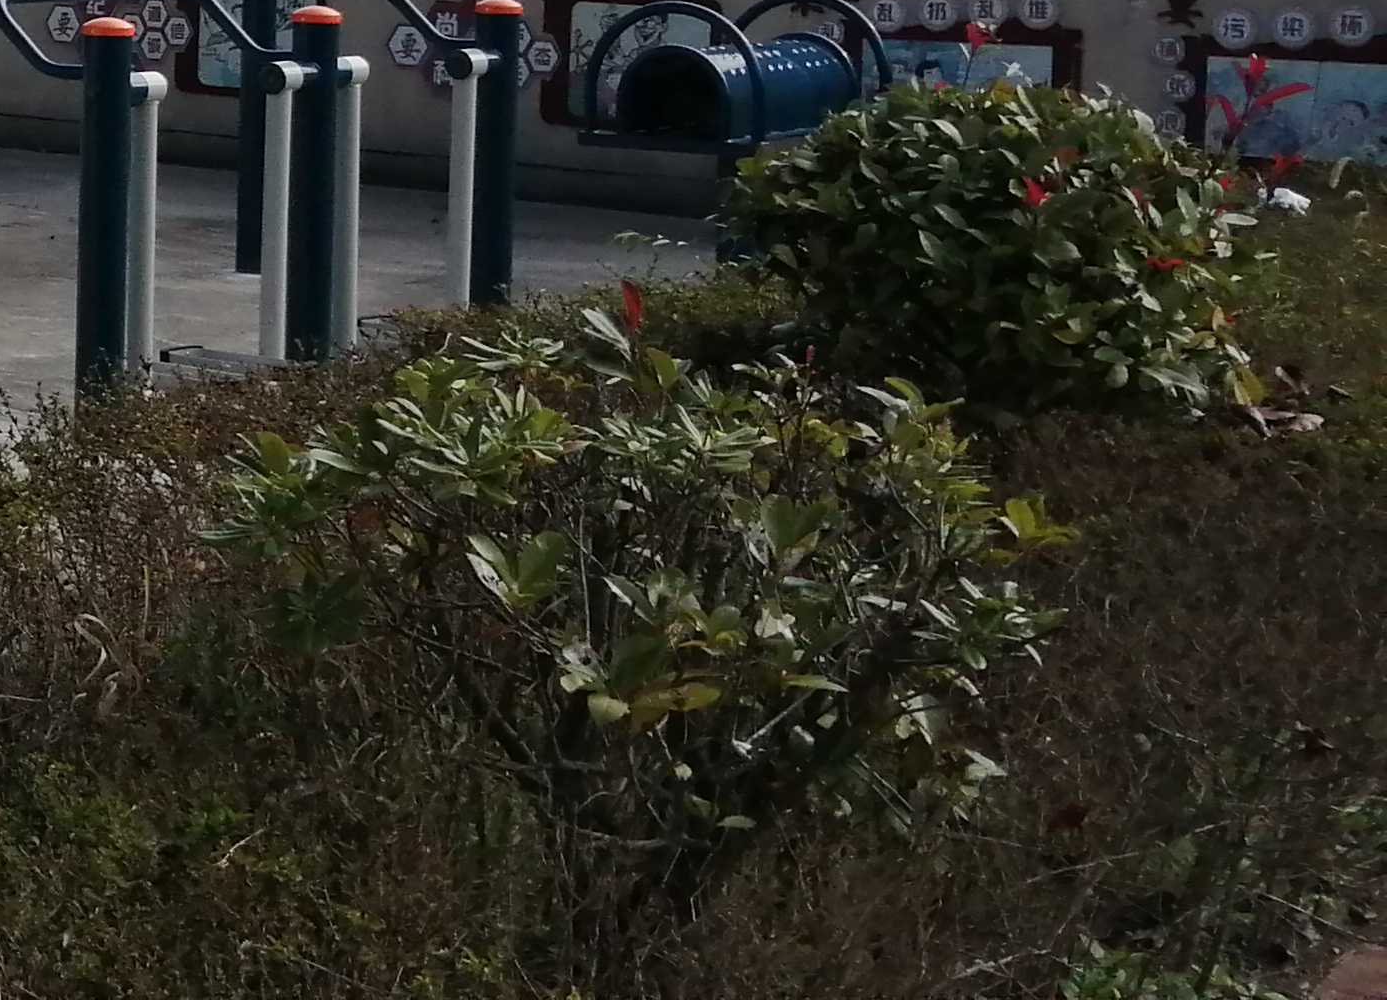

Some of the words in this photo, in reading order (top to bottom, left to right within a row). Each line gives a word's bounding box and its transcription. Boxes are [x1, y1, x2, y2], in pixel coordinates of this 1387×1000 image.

[877, 0, 1048, 22] 乱扔乱堆
[54, 12, 75, 37] 要
[1223, 14, 1363, 39] 污染环
[395, 33, 422, 60] 要
